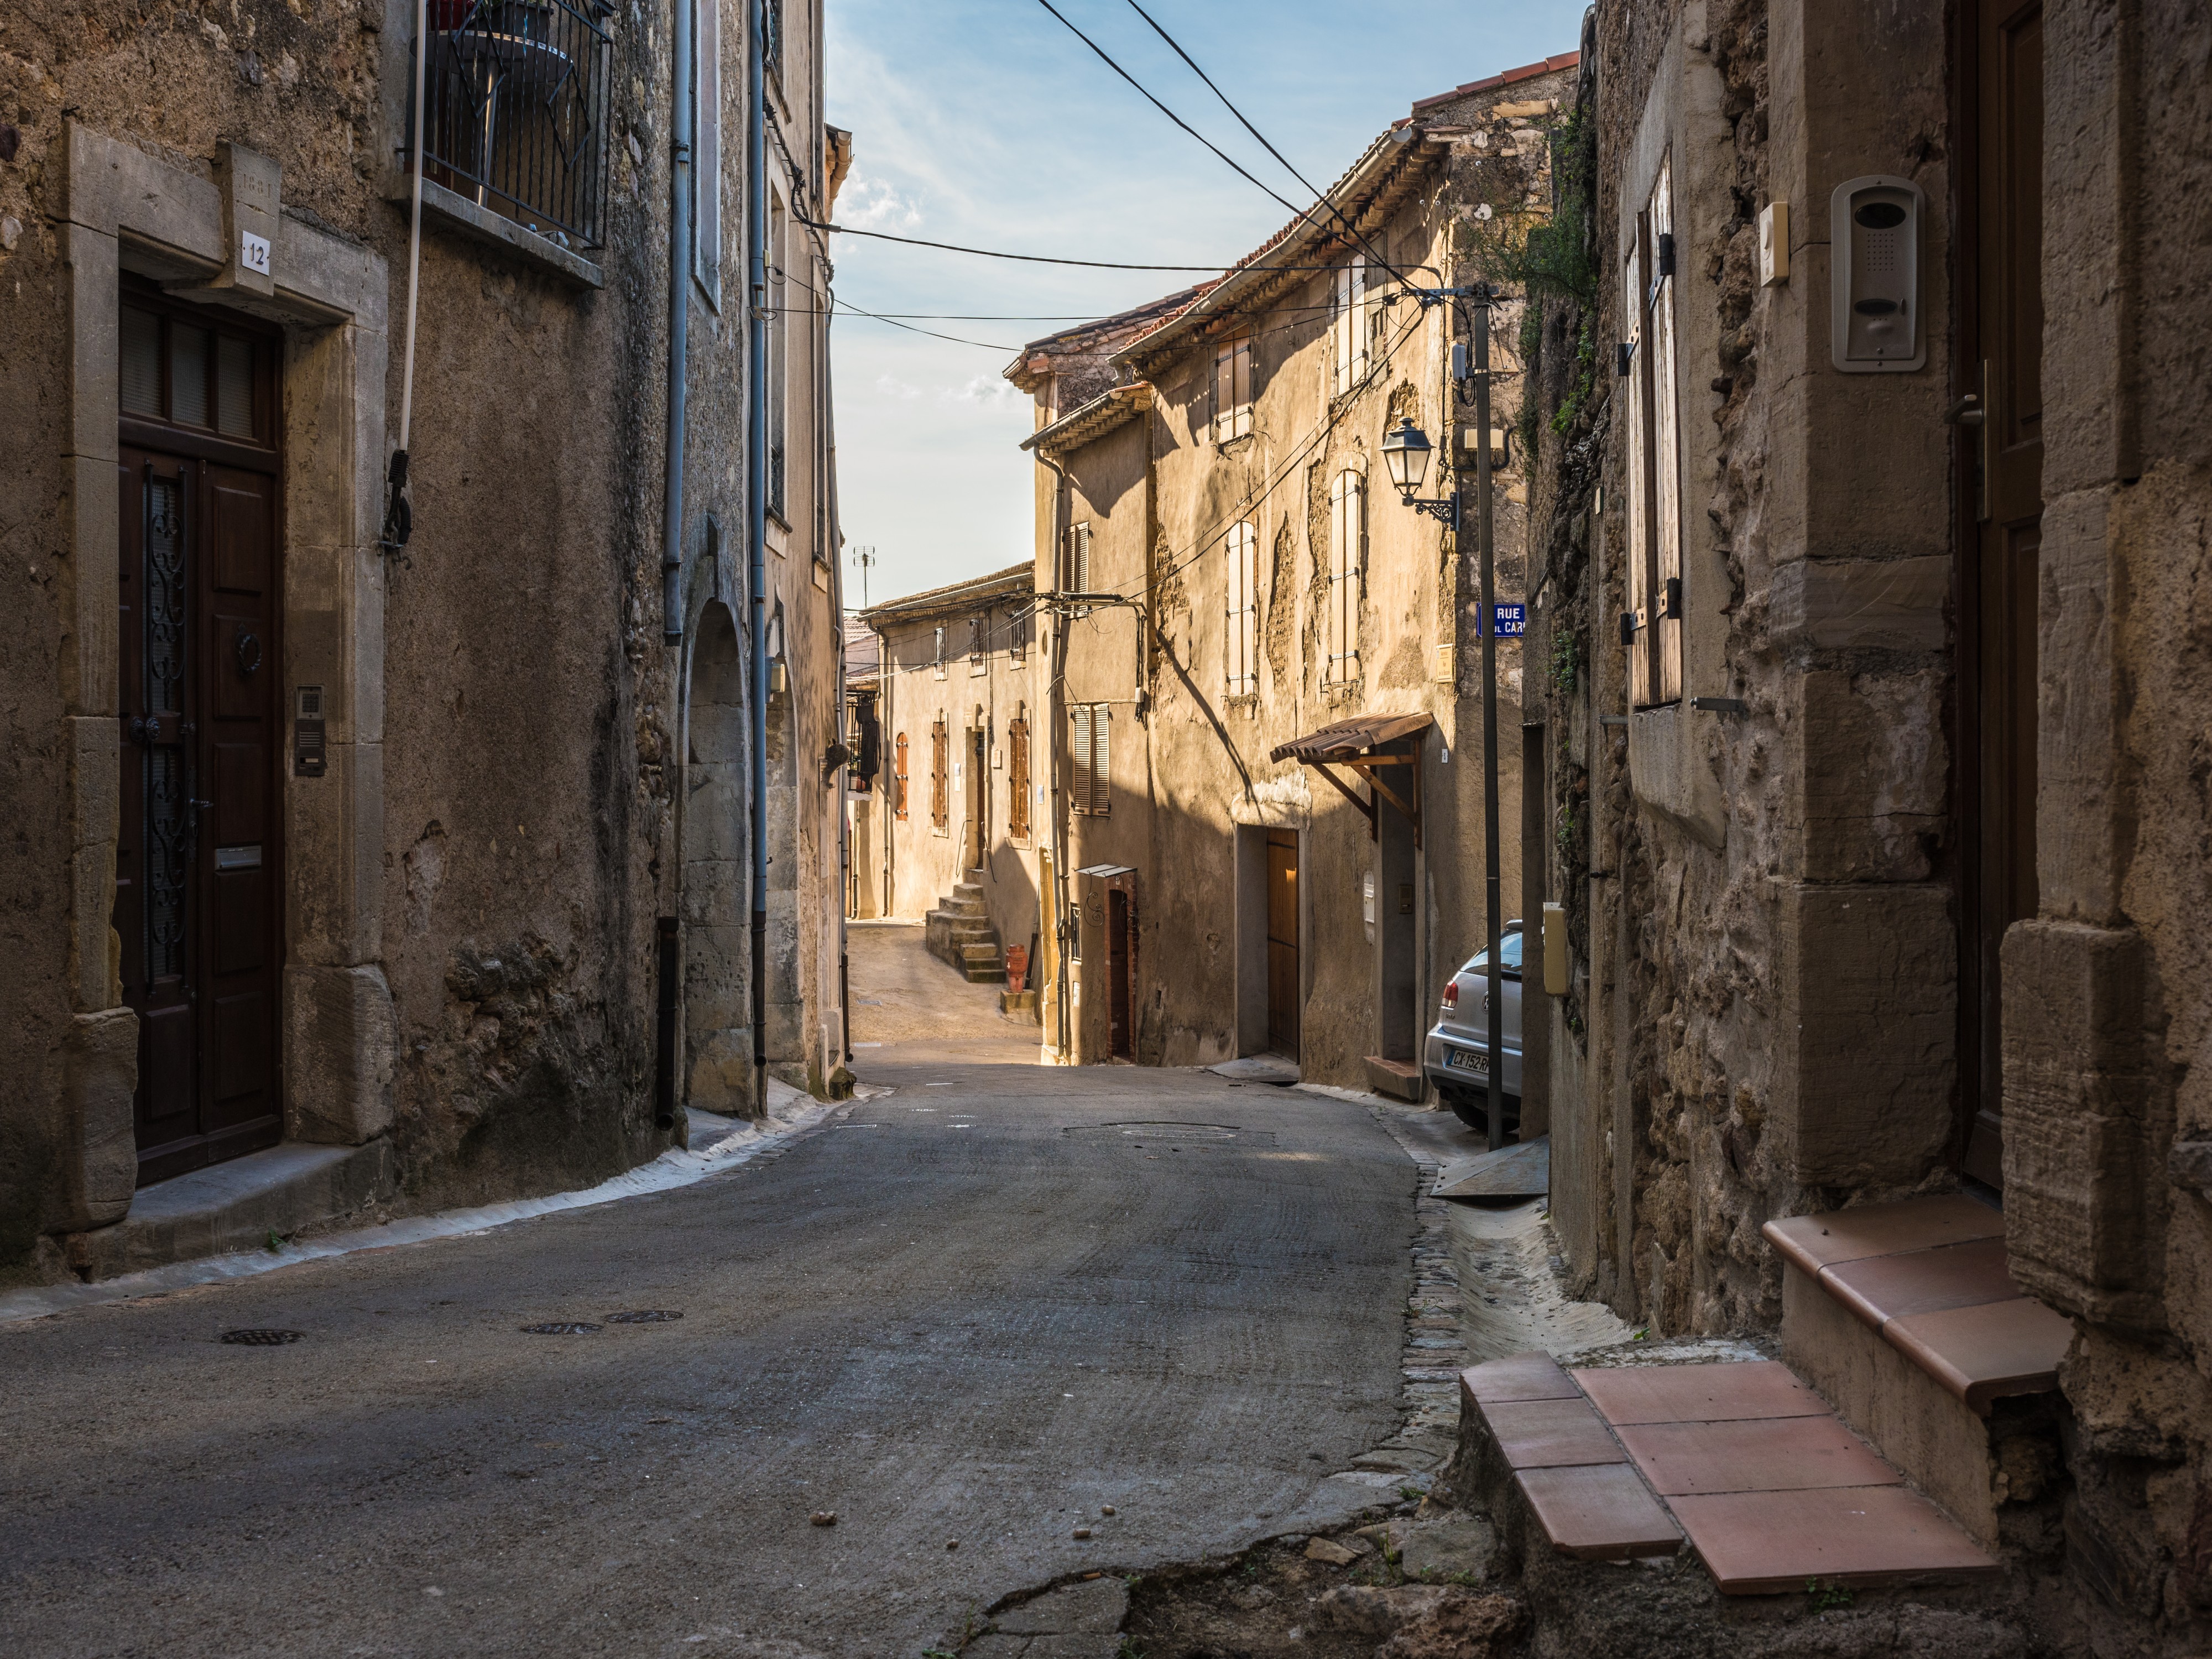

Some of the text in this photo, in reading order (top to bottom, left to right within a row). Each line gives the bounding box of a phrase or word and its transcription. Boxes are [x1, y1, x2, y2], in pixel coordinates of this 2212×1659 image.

[243, 174, 270, 199] 1881
[250, 243, 264, 265] 12
[1497, 608, 1520, 619] RUE
[1505, 622, 1525, 633] CAR
